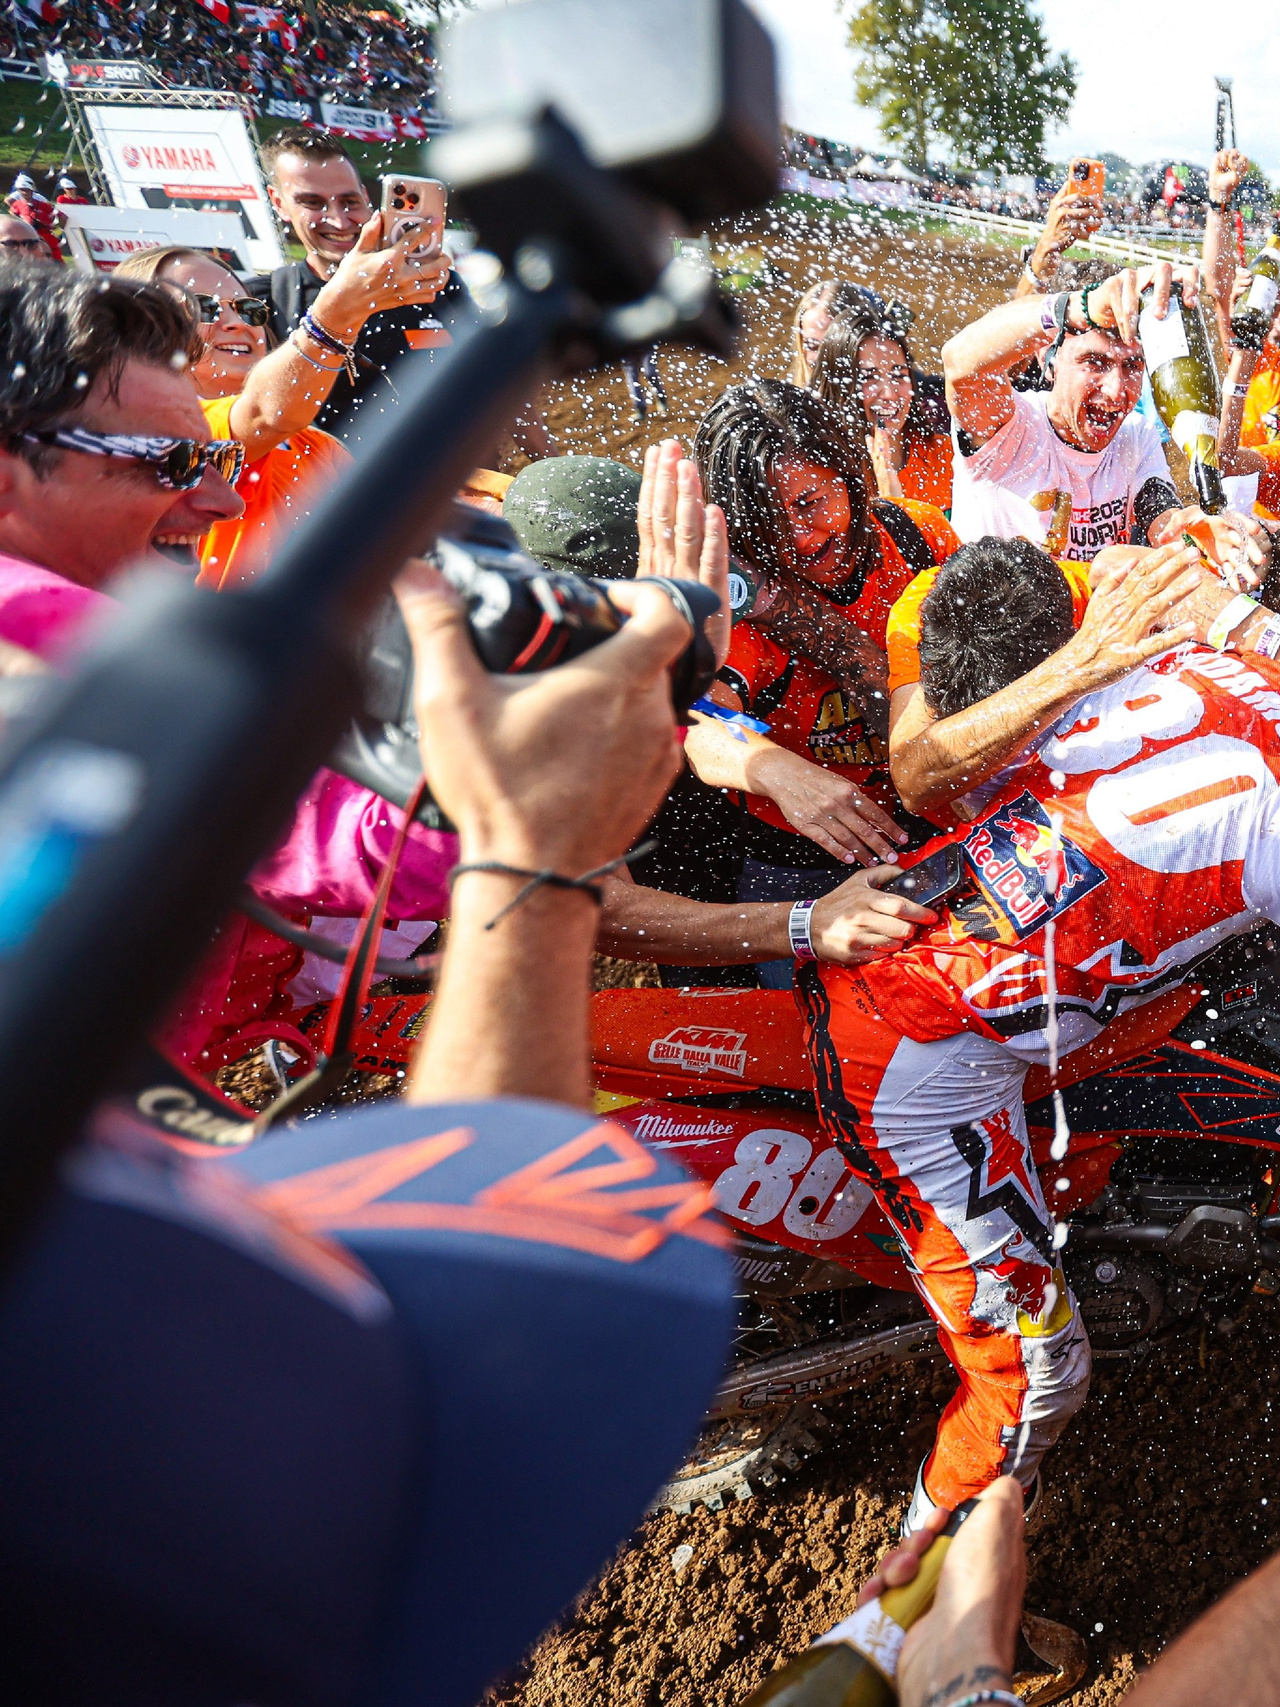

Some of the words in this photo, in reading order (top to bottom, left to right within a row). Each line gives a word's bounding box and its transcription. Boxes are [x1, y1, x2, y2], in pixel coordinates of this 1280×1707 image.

[141, 146, 218, 172] YAMAHA
[667, 1029, 741, 1051] KTM
[683, 1049, 711, 1063] DALLA
[714, 1053, 742, 1070] VALLE
[632, 1113, 734, 1138] Milwaukee
[708, 1128, 875, 1240] 80
